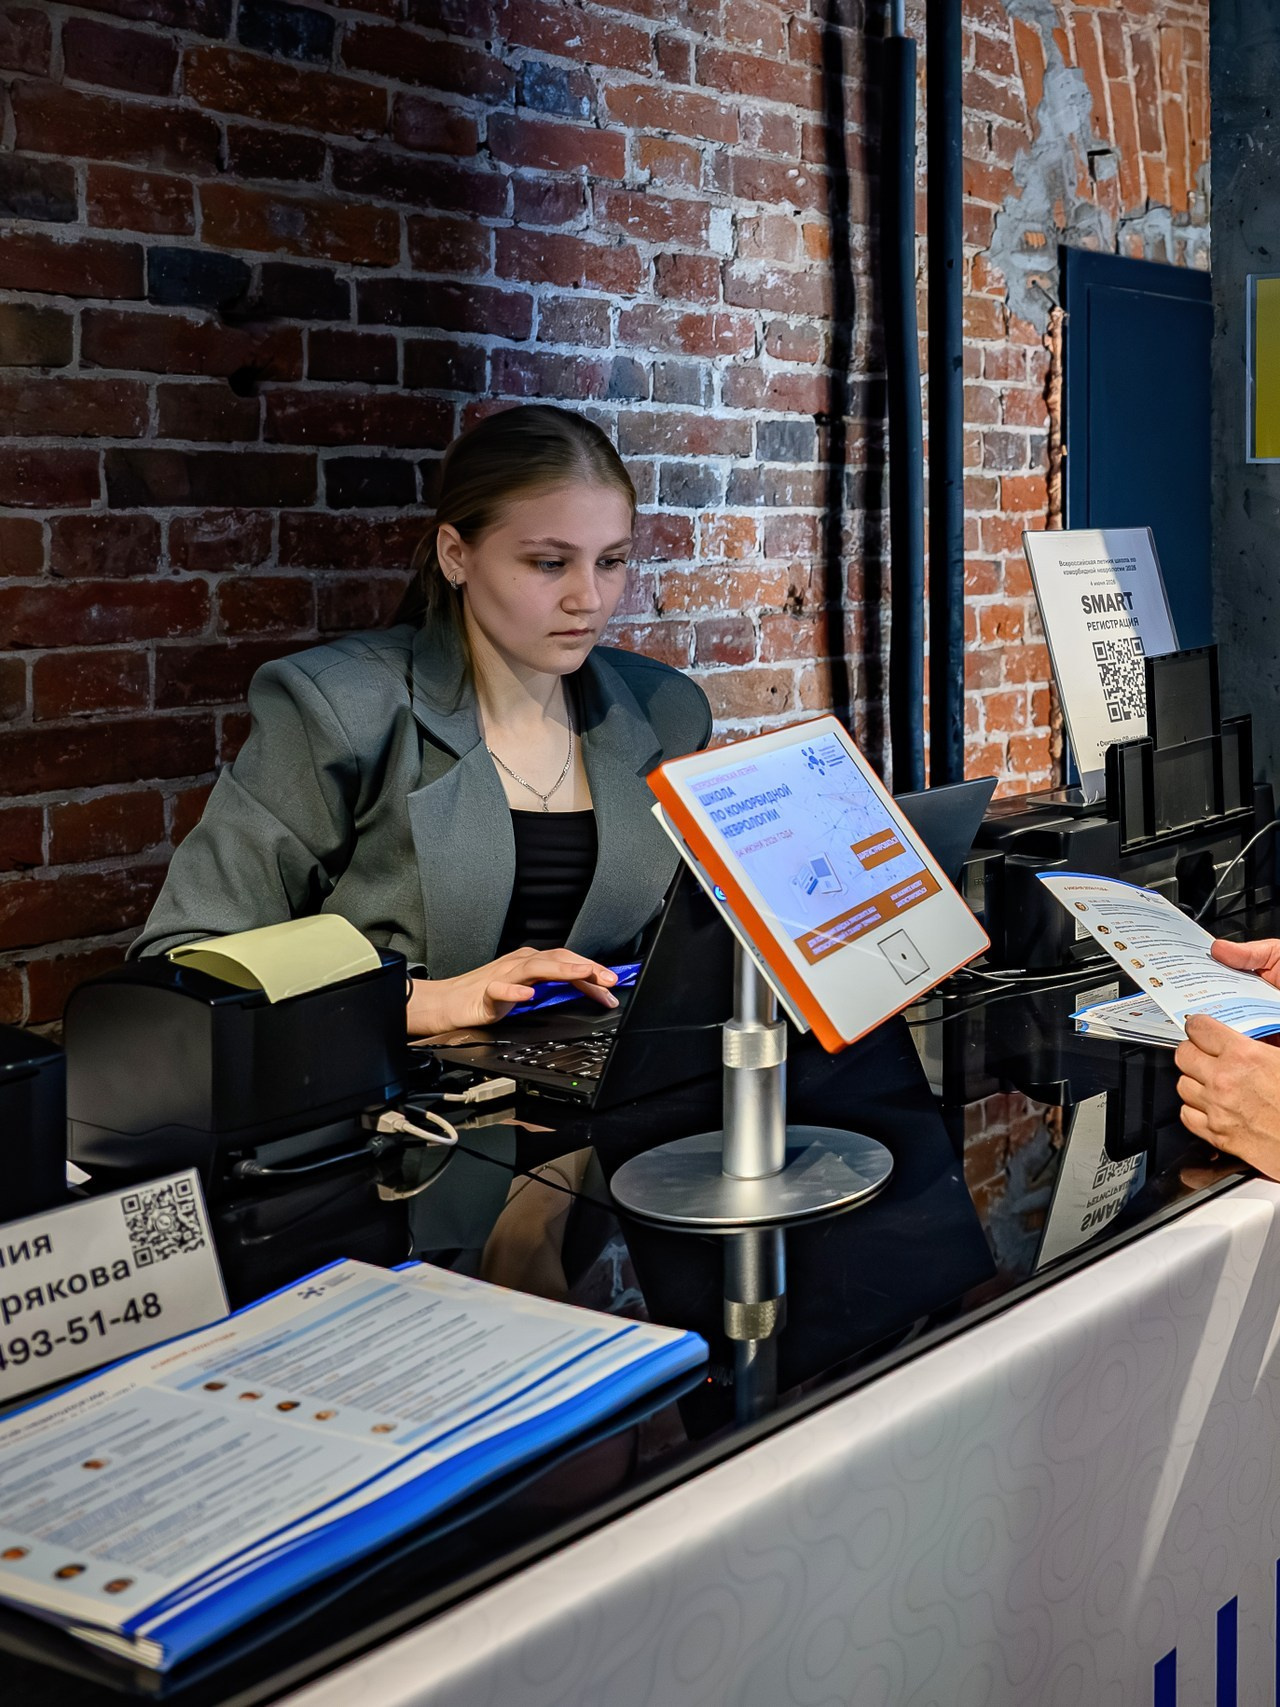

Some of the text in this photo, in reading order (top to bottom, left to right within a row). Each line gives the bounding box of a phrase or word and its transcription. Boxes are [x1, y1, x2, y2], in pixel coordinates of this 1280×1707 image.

[1081, 592, 1134, 615] SMART
[1087, 617, 1140, 631] РЕГИСТРАЦИЯ
[698, 785, 736, 807] ШКОЛА
[709, 783, 793, 823] ПО КОМОРБИДНОЙ
[720, 808, 781, 838] НЕВРОЛОГИИ
